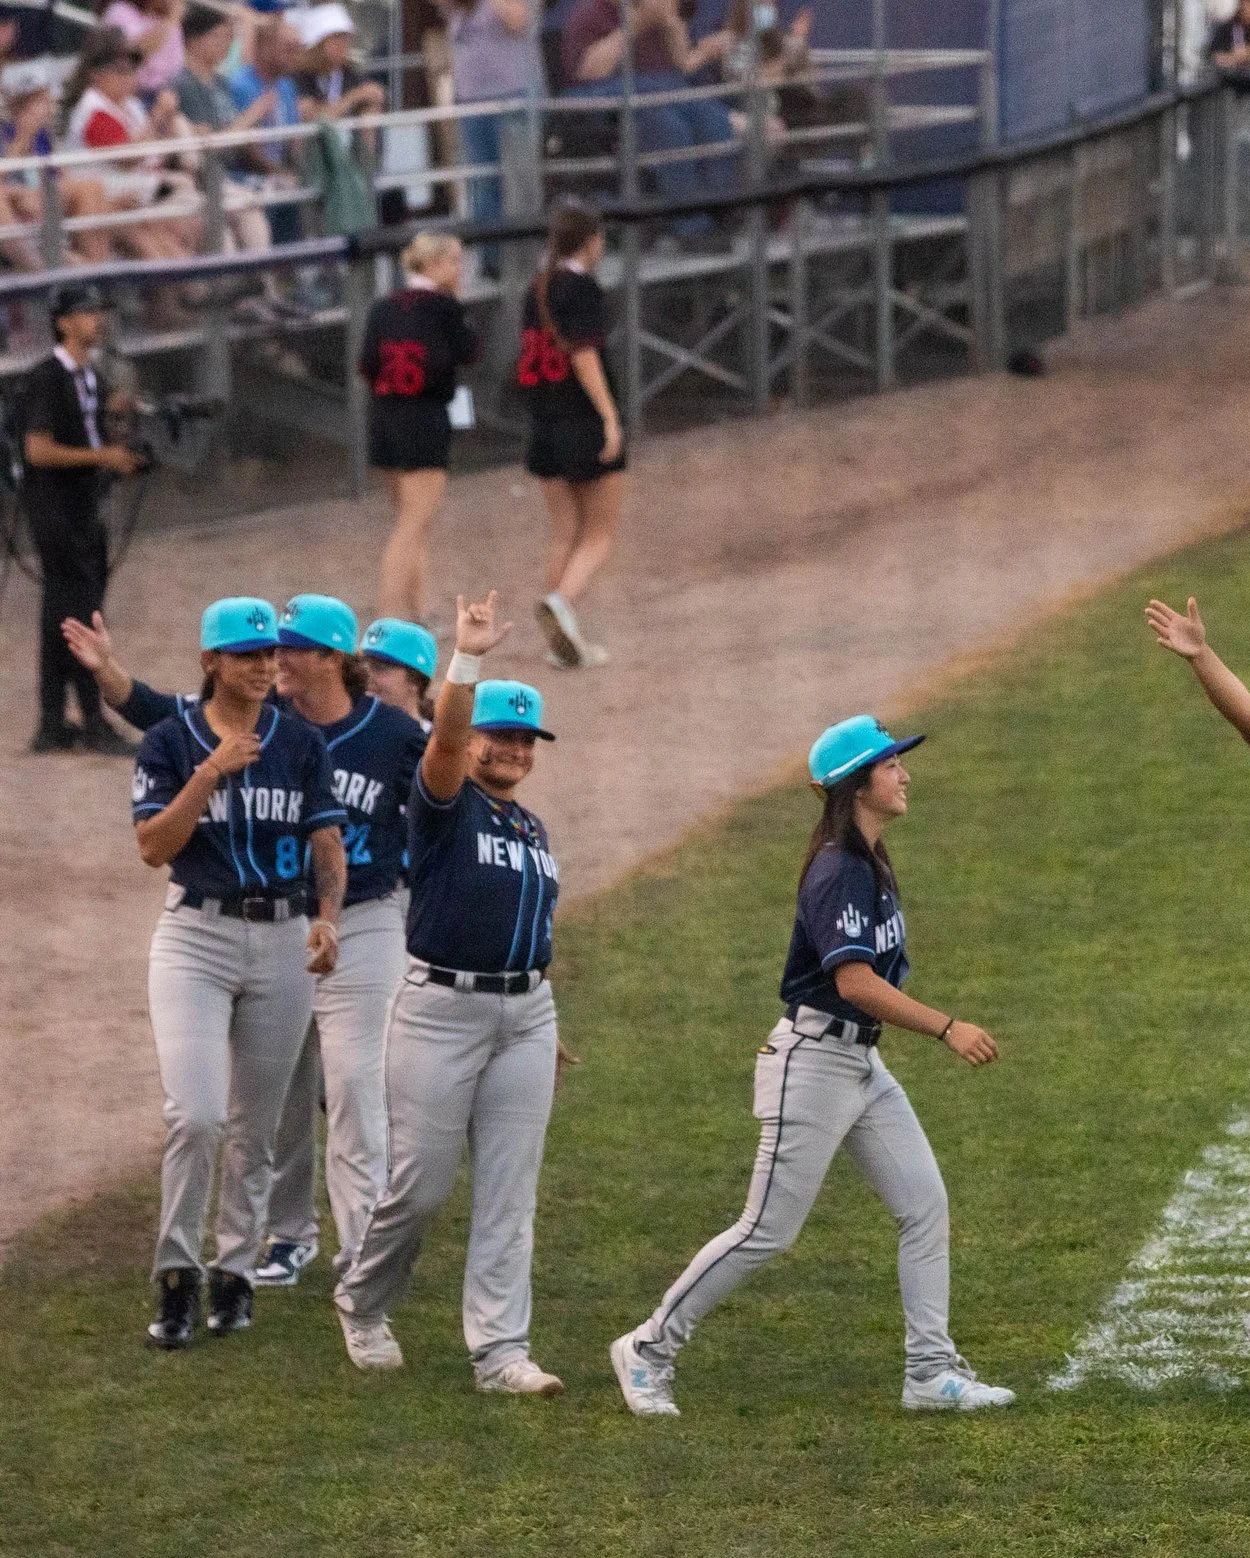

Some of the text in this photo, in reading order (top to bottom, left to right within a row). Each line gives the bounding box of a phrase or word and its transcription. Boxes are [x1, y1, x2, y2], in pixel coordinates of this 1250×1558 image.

[240, 786, 304, 824] YORK
[275, 835, 298, 880] 8
[477, 832, 523, 873] NEW
